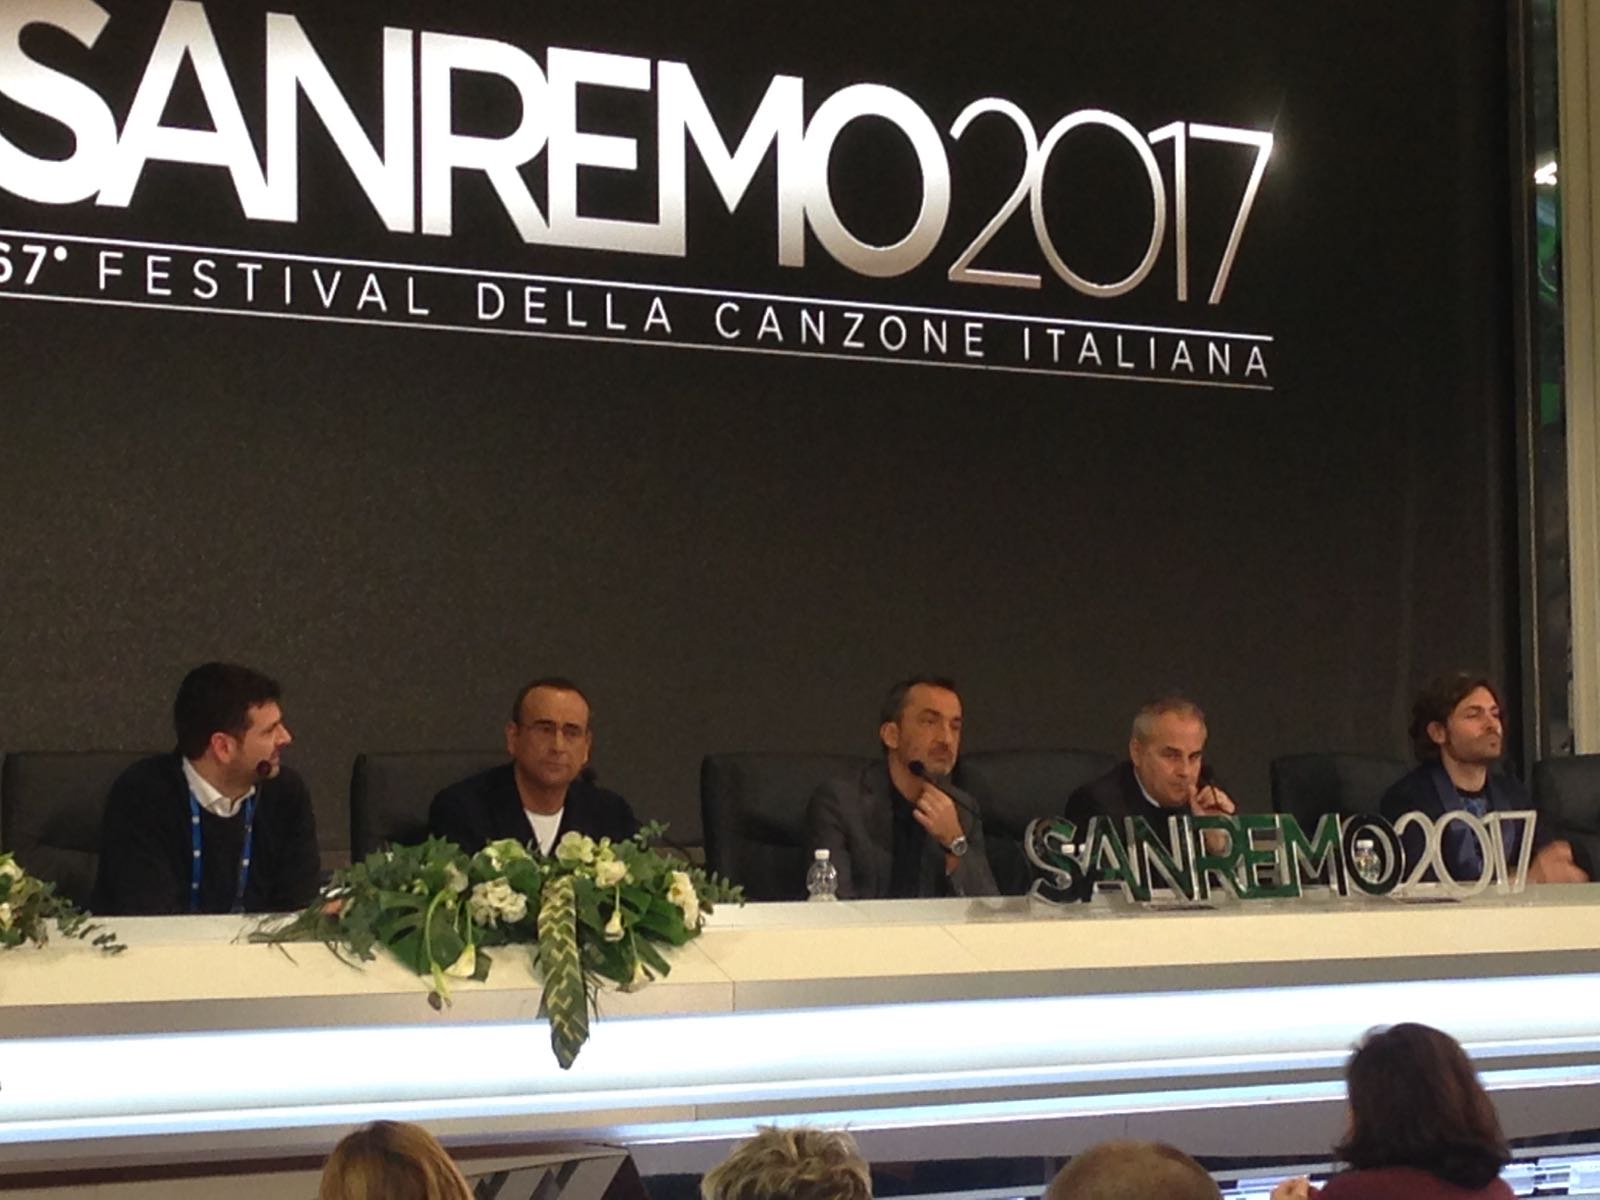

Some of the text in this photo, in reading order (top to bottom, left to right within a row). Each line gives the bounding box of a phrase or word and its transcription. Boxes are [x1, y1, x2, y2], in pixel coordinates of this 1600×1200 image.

[99, 250, 430, 316] FESTIVAL
[477, 281, 672, 334] DELLA
[715, 301, 984, 358] CANZONE
[1023, 327, 1268, 378] ITALIANA
